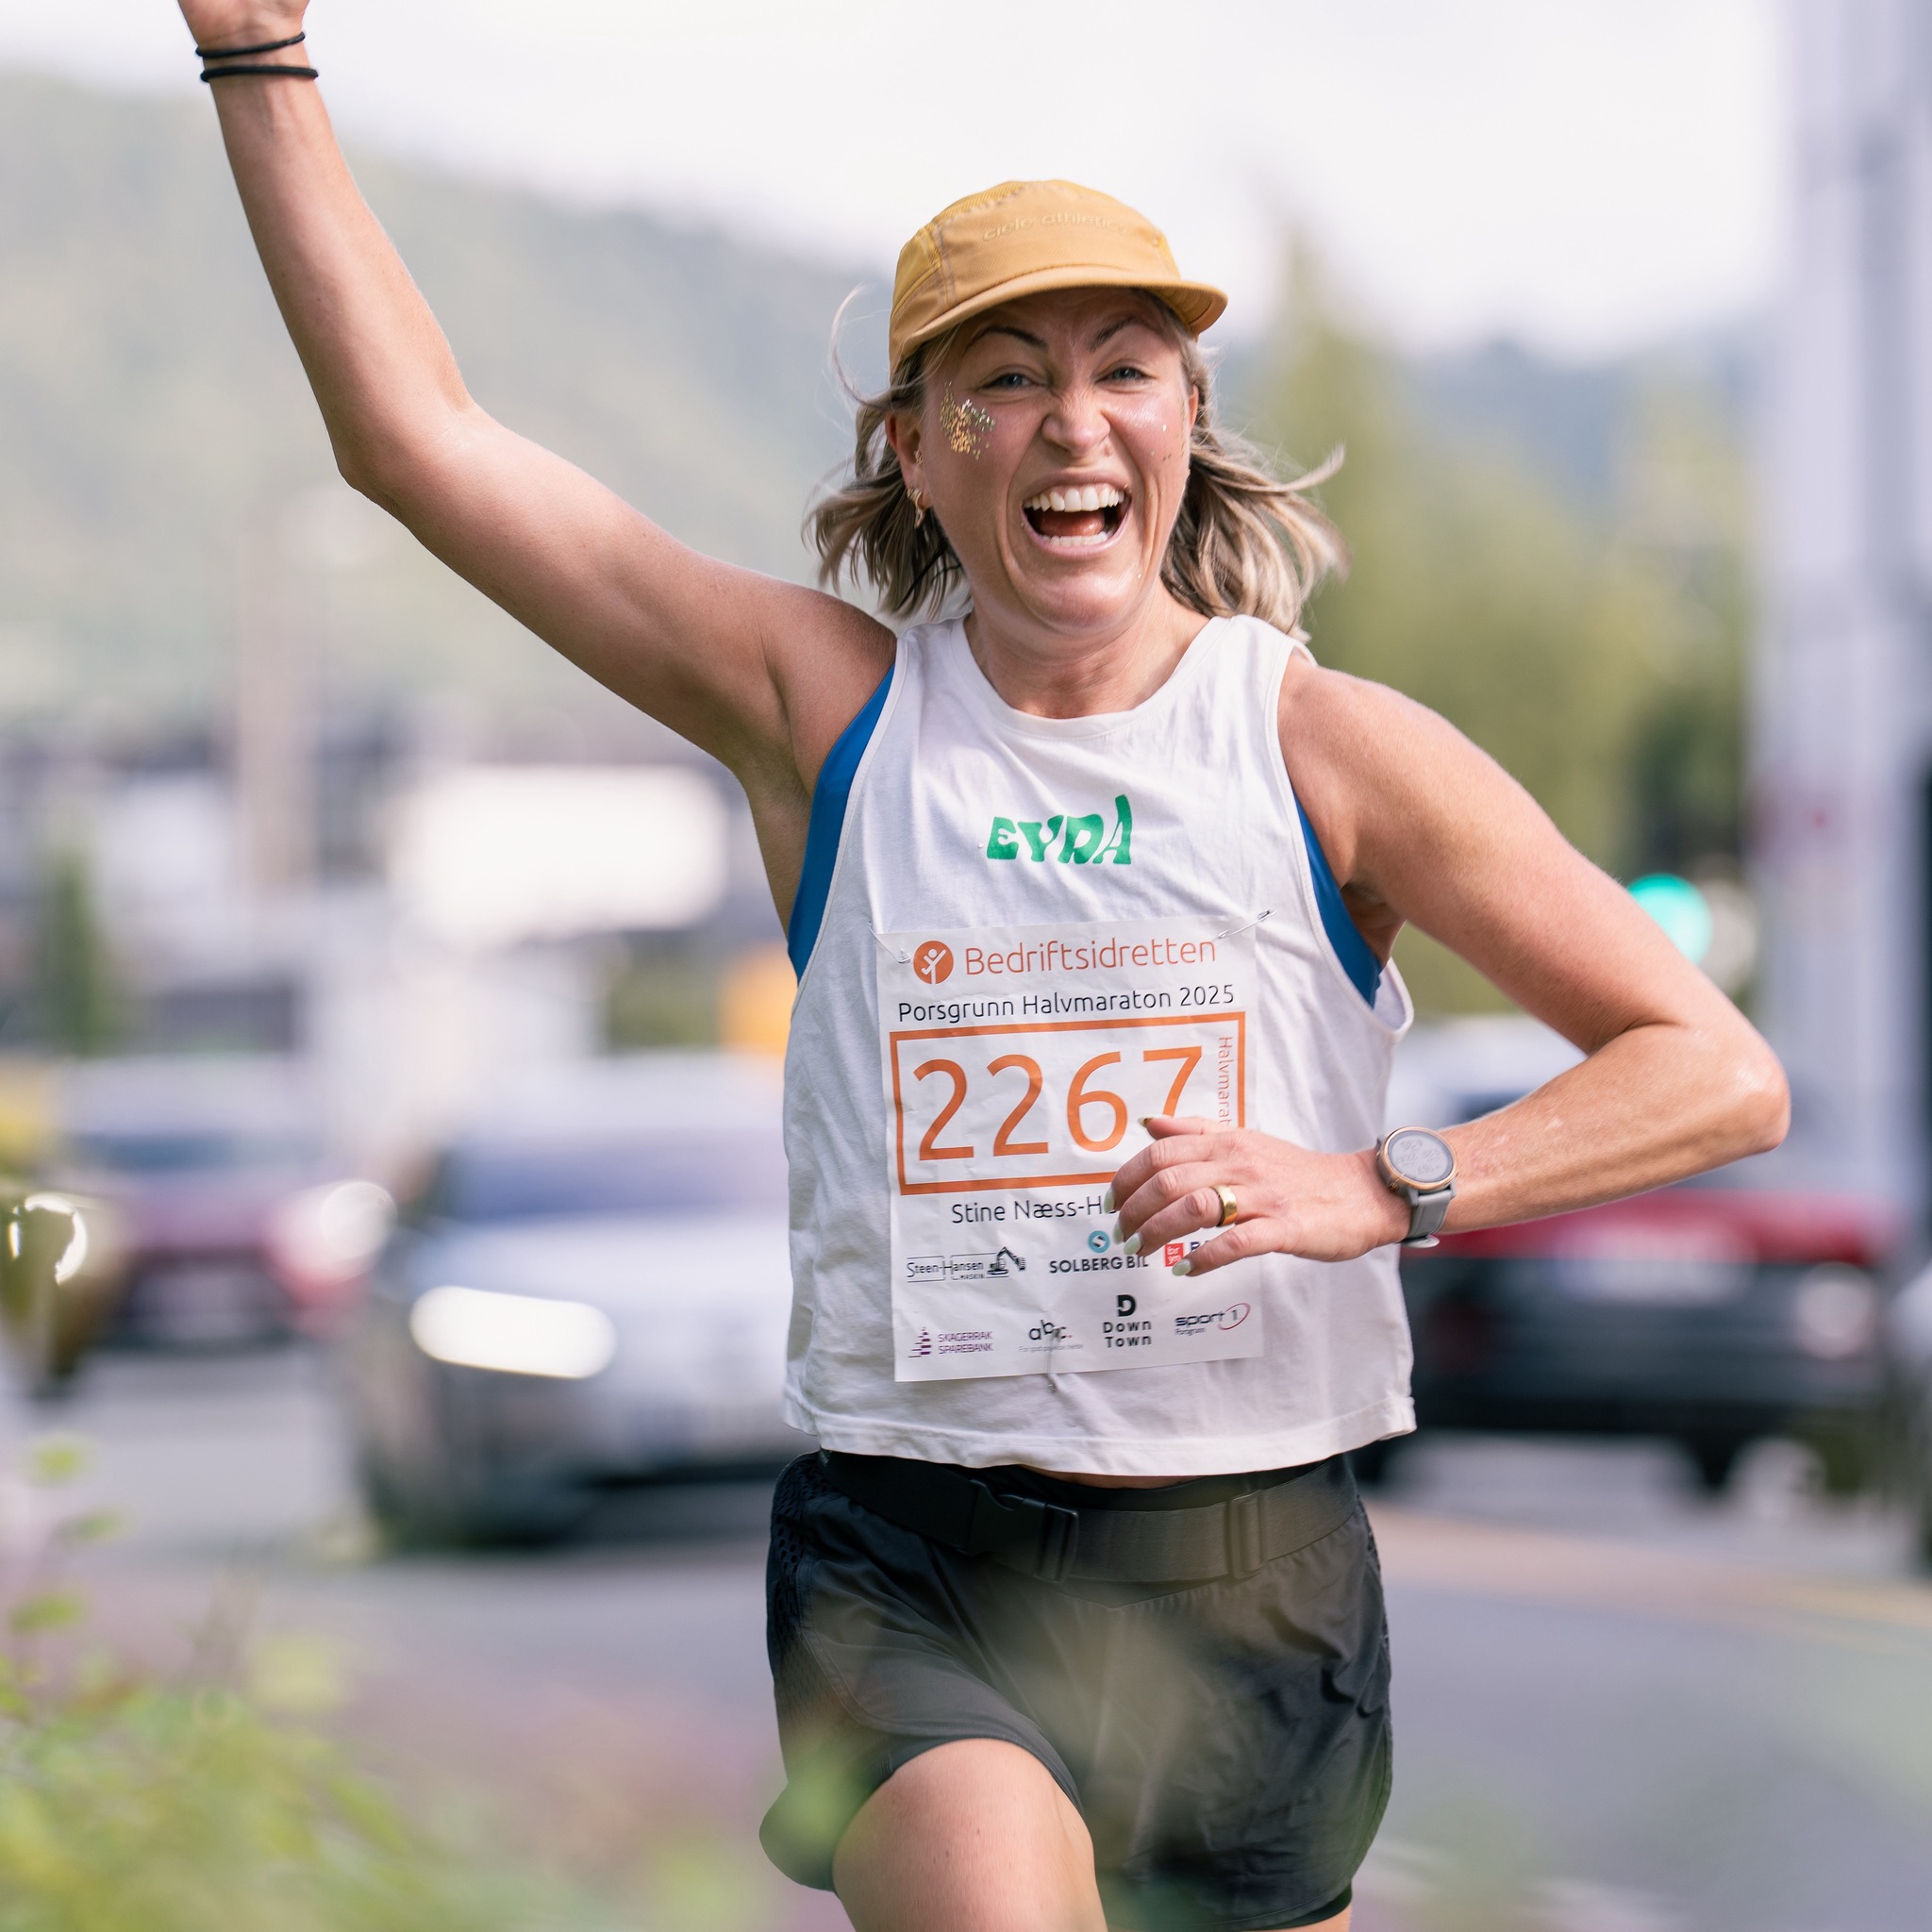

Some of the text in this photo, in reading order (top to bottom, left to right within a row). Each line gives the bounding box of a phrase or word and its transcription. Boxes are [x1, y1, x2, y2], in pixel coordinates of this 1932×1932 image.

[965, 937, 1216, 975] Bedriftsidretten
[898, 984, 1235, 1024] Porsgrunn Halvmaraton 2025
[1218, 1036, 1234, 1126] Halvmarat
[912, 1045, 1203, 1161] 2267
[952, 1195, 1118, 1224] Stine Næss-H
[907, 1260, 985, 1278] Steen-Hansen
[1049, 1256, 1149, 1274] SOLBERG BIL
[1103, 1321, 1152, 1334] Down
[1105, 1335, 1152, 1348] Town
